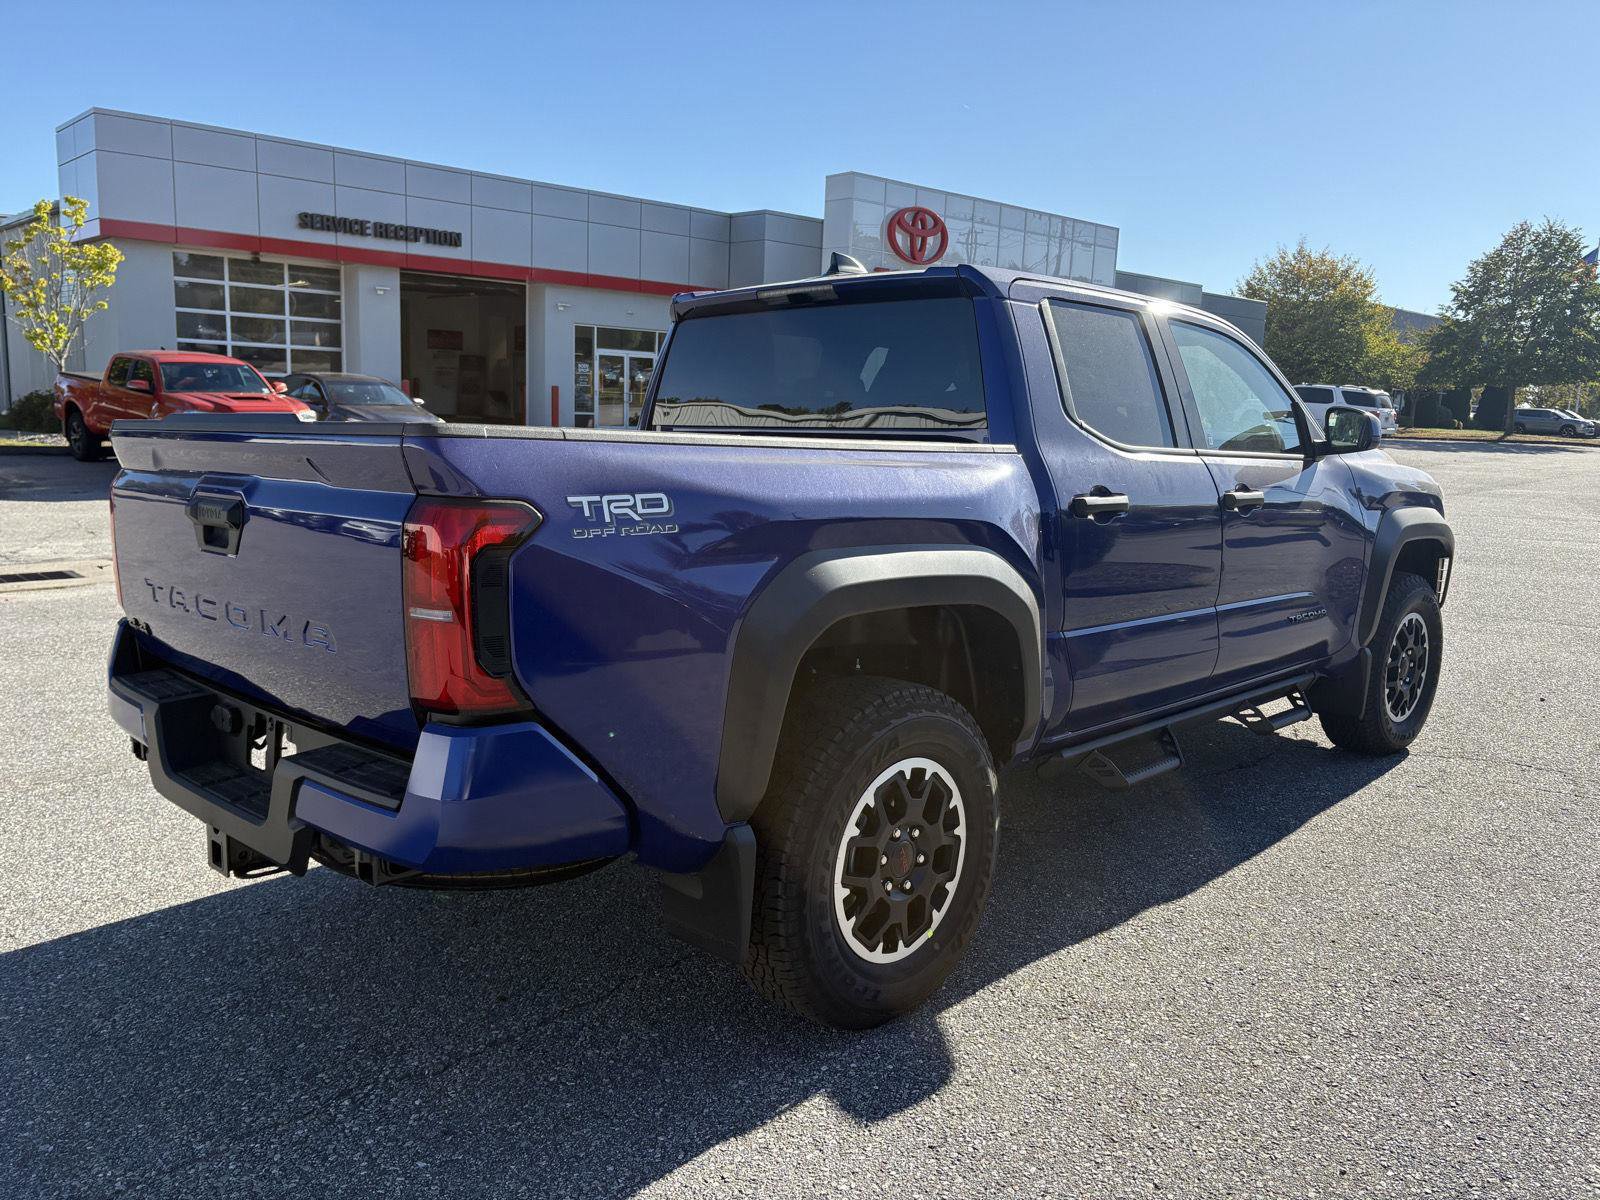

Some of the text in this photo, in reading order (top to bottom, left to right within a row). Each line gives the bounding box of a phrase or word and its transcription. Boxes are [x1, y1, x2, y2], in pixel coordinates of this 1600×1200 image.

[298, 211, 462, 247] SERVICE RECEPTION
[566, 492, 674, 525] TRD
[572, 523, 679, 539] OFF ROAD
[144, 577, 336, 653] TACOMA
